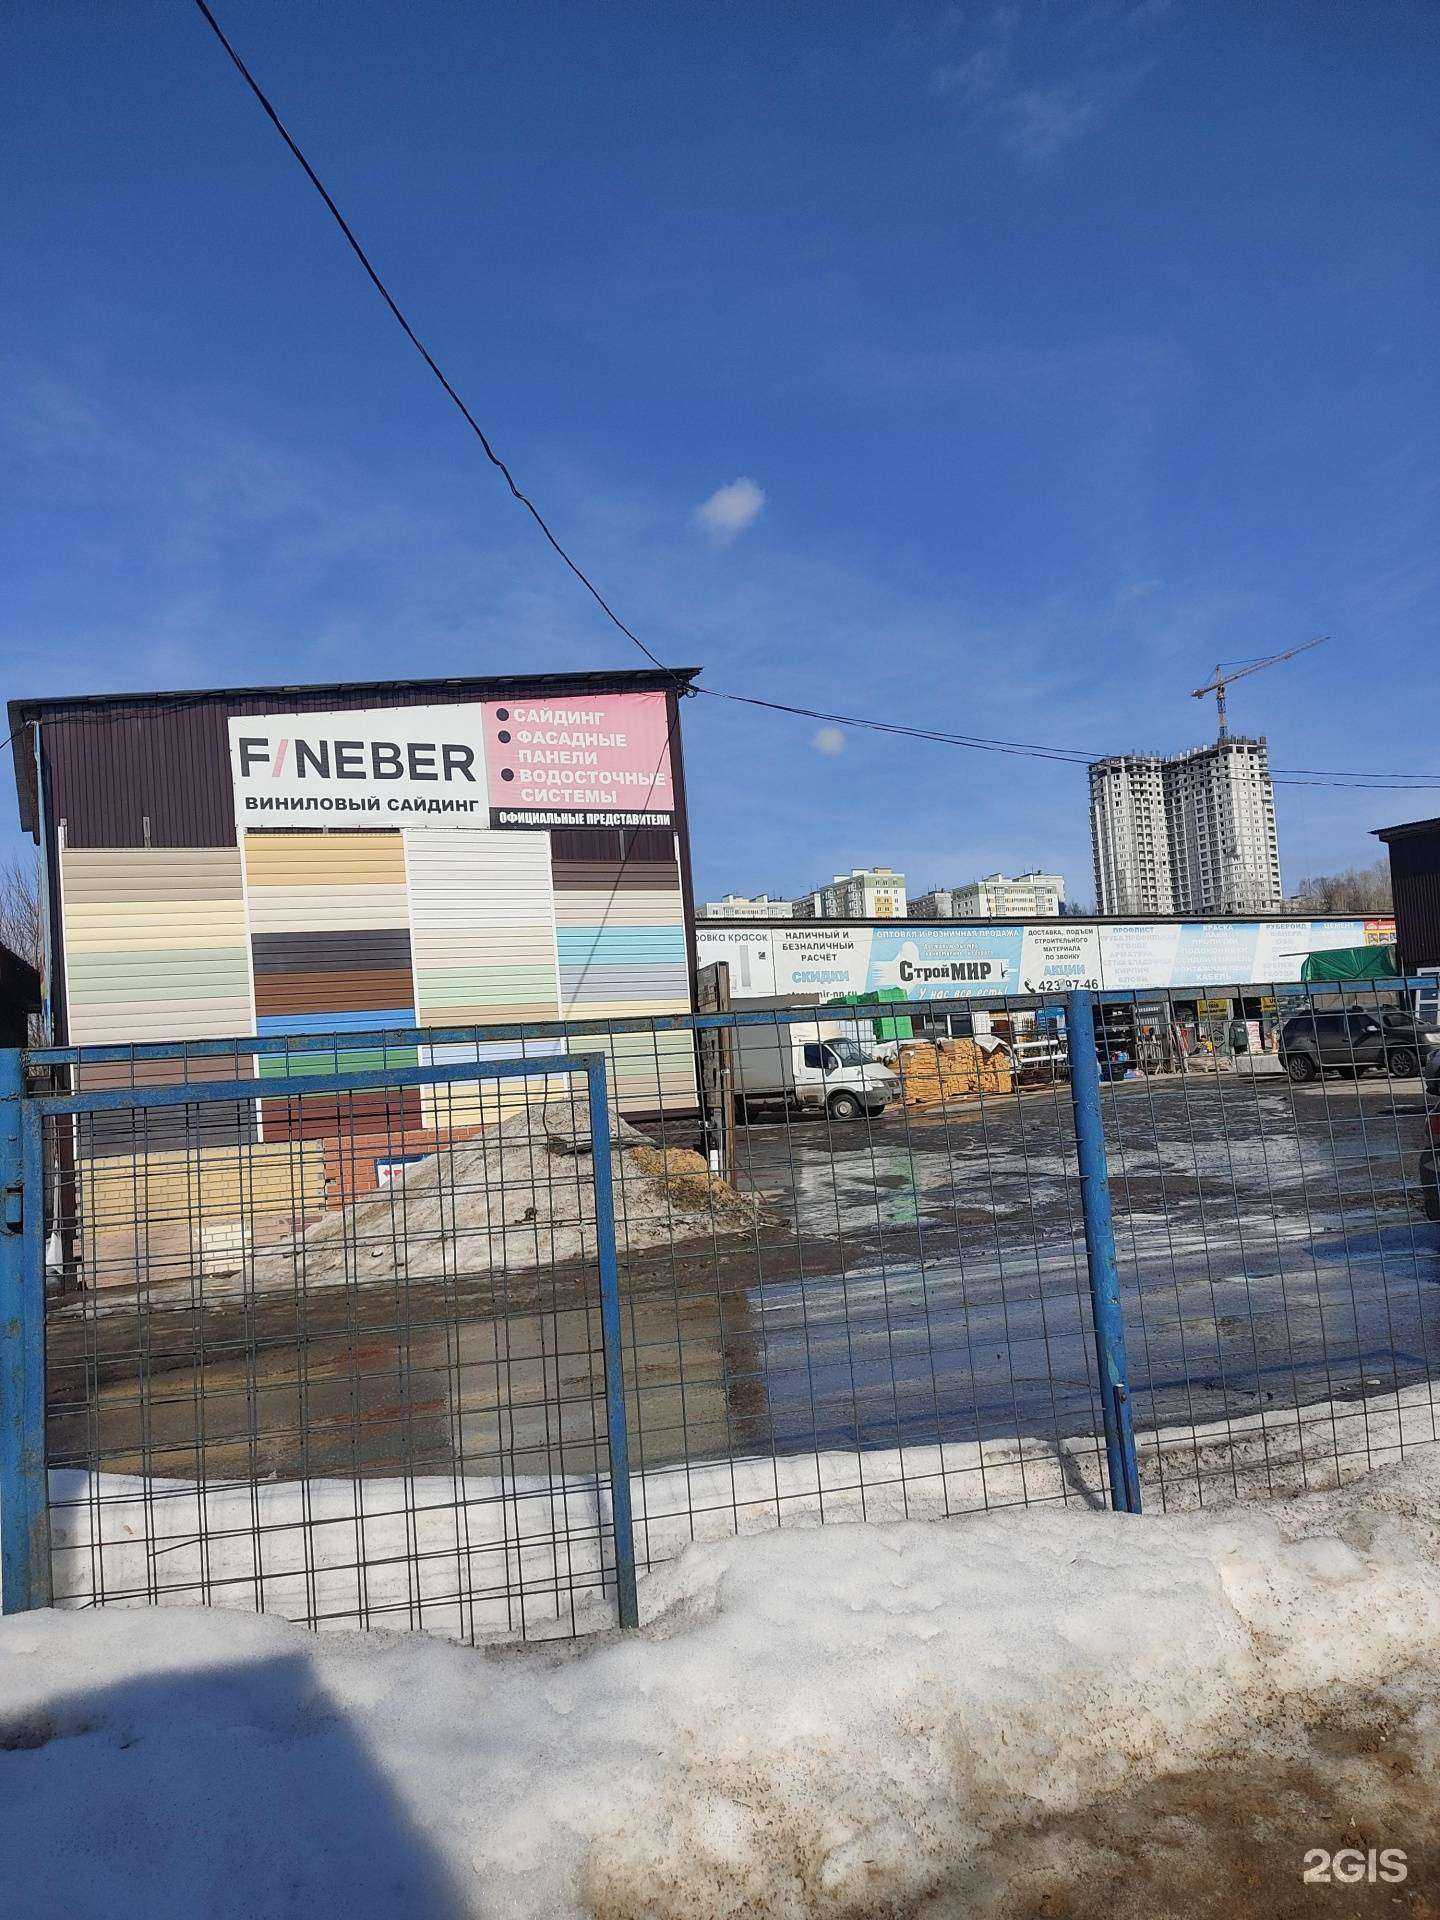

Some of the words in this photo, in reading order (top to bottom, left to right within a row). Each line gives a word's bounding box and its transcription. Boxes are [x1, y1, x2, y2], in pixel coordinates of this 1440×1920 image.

[513, 707, 606, 726] САЙДИНГ
[516, 730, 628, 747] ФАСАДНЫЕ
[518, 749, 598, 765] ПАНЕЛИ
[519, 769, 666, 786] ВОДОСТОЧНЫЕ
[520, 788, 617, 804] СИСТЕМЫ
[245, 796, 380, 811] ВИНИЛОВЫЙ
[387, 796, 479, 814] САЙДИНГ
[499, 811, 585, 826] ОФИЦИАЛЬНЫЕ
[586, 813, 671, 827] ПРЕДСТАВИТЕЛИ
[728, 933, 768, 944] красок
[785, 930, 840, 940] НАЛИЧНЫЙ
[876, 930, 917, 939] ОПТОВАЯ
[979, 929, 1020, 938] ПРОДАЖА
[1113, 927, 1154, 935] ПРОФЛИСТ
[782, 942, 855, 951] БЕЗНАЛИЧНЫЙ
[791, 970, 850, 985] СКИДКИ
[899, 960, 992, 982] СтройМИР
